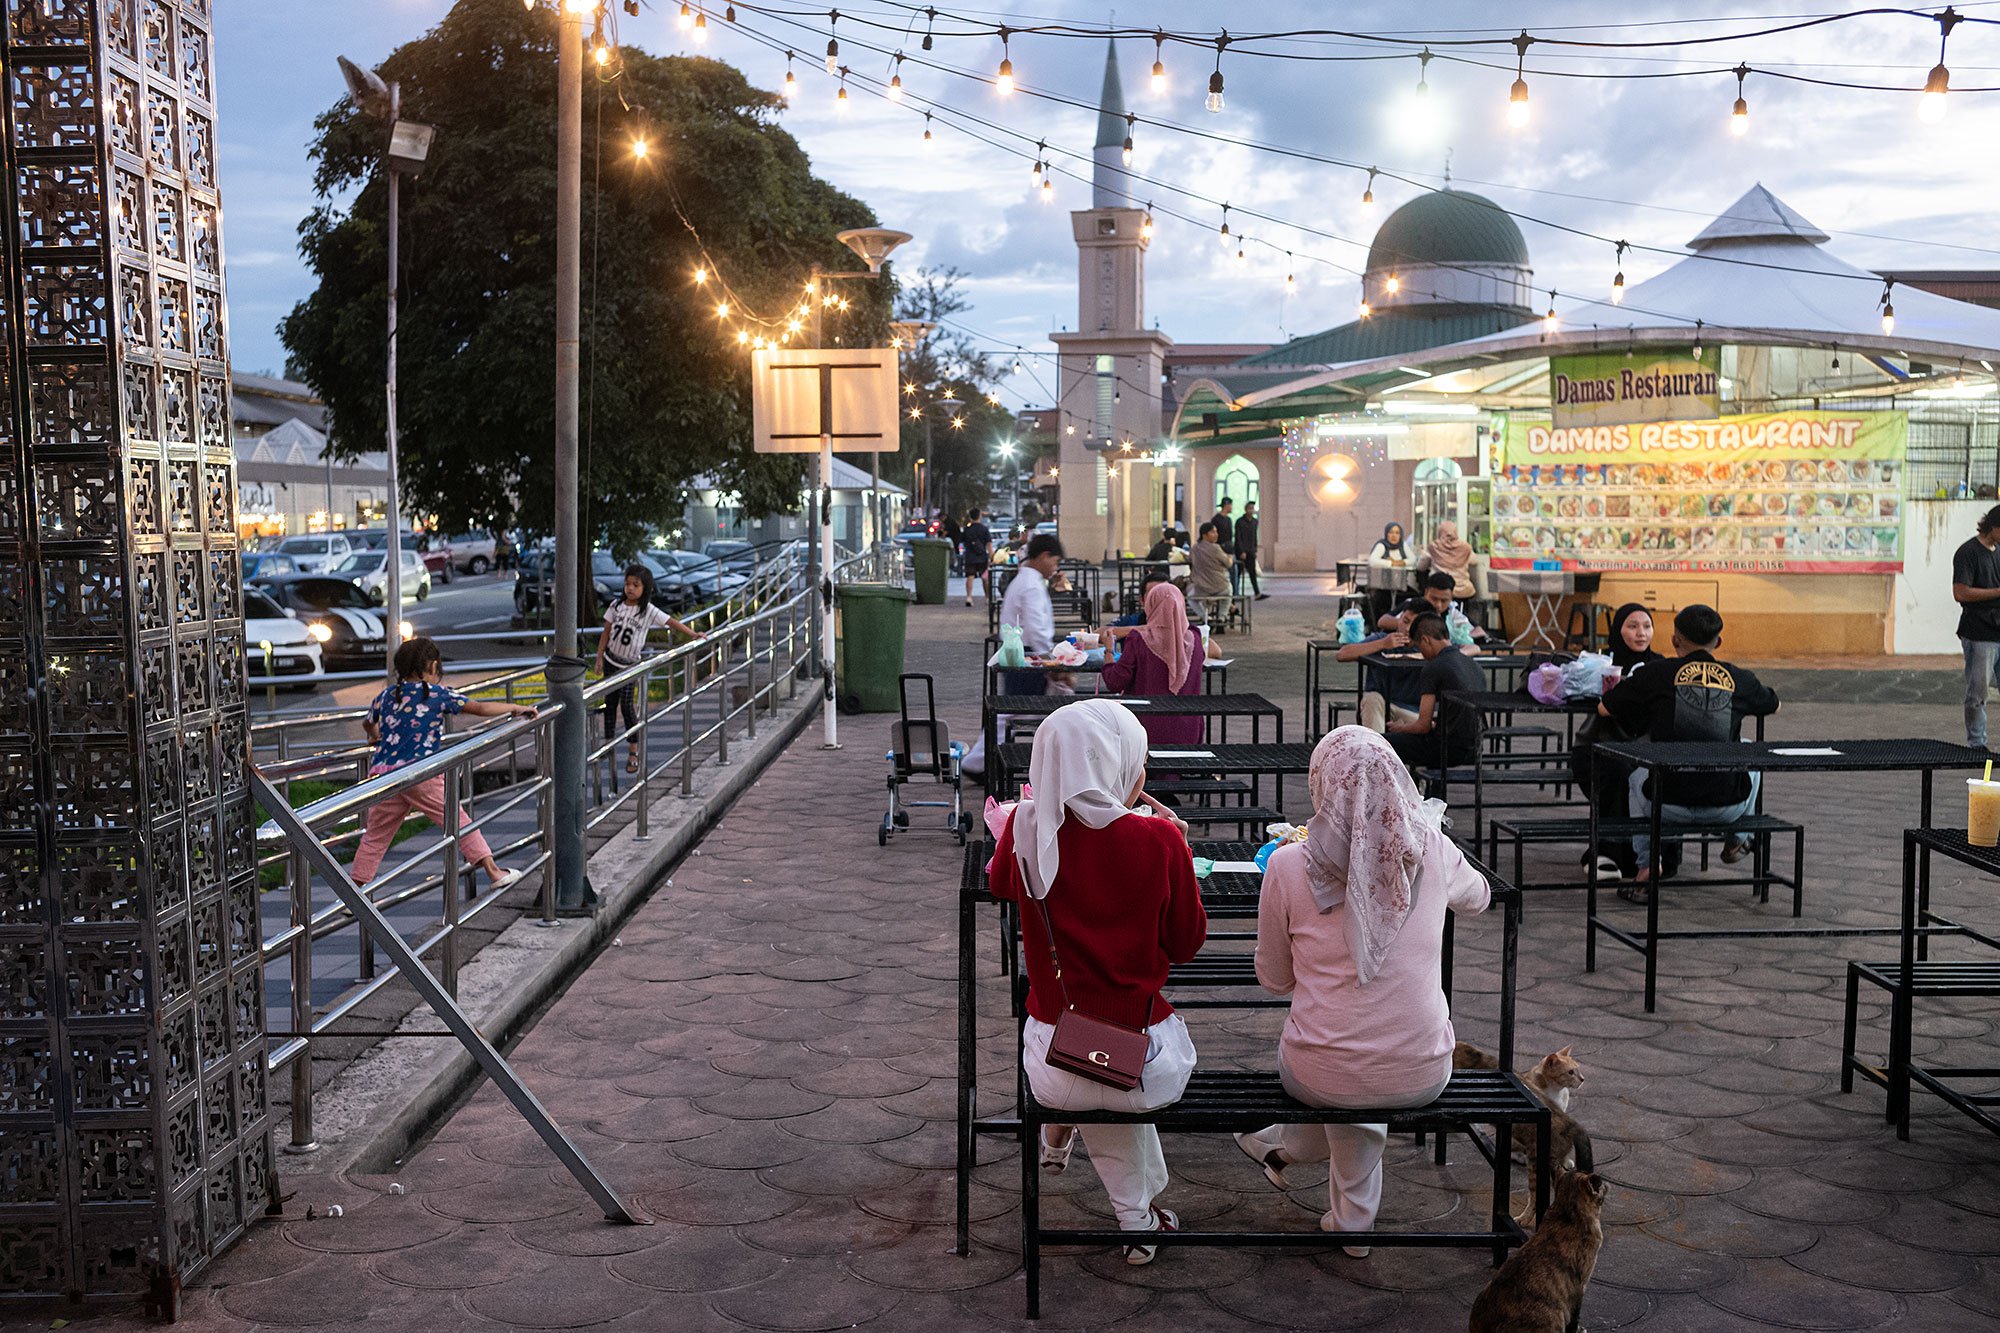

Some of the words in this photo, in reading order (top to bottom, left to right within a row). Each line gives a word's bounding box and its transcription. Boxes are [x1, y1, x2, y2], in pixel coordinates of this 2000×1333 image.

[1556, 374, 1615, 404] Damas
[1528, 426, 1630, 454] DAMAS
[1641, 420, 1862, 451] RESTAURANT
[612, 624, 634, 646] 76
[1088, 1051, 1110, 1067] C
